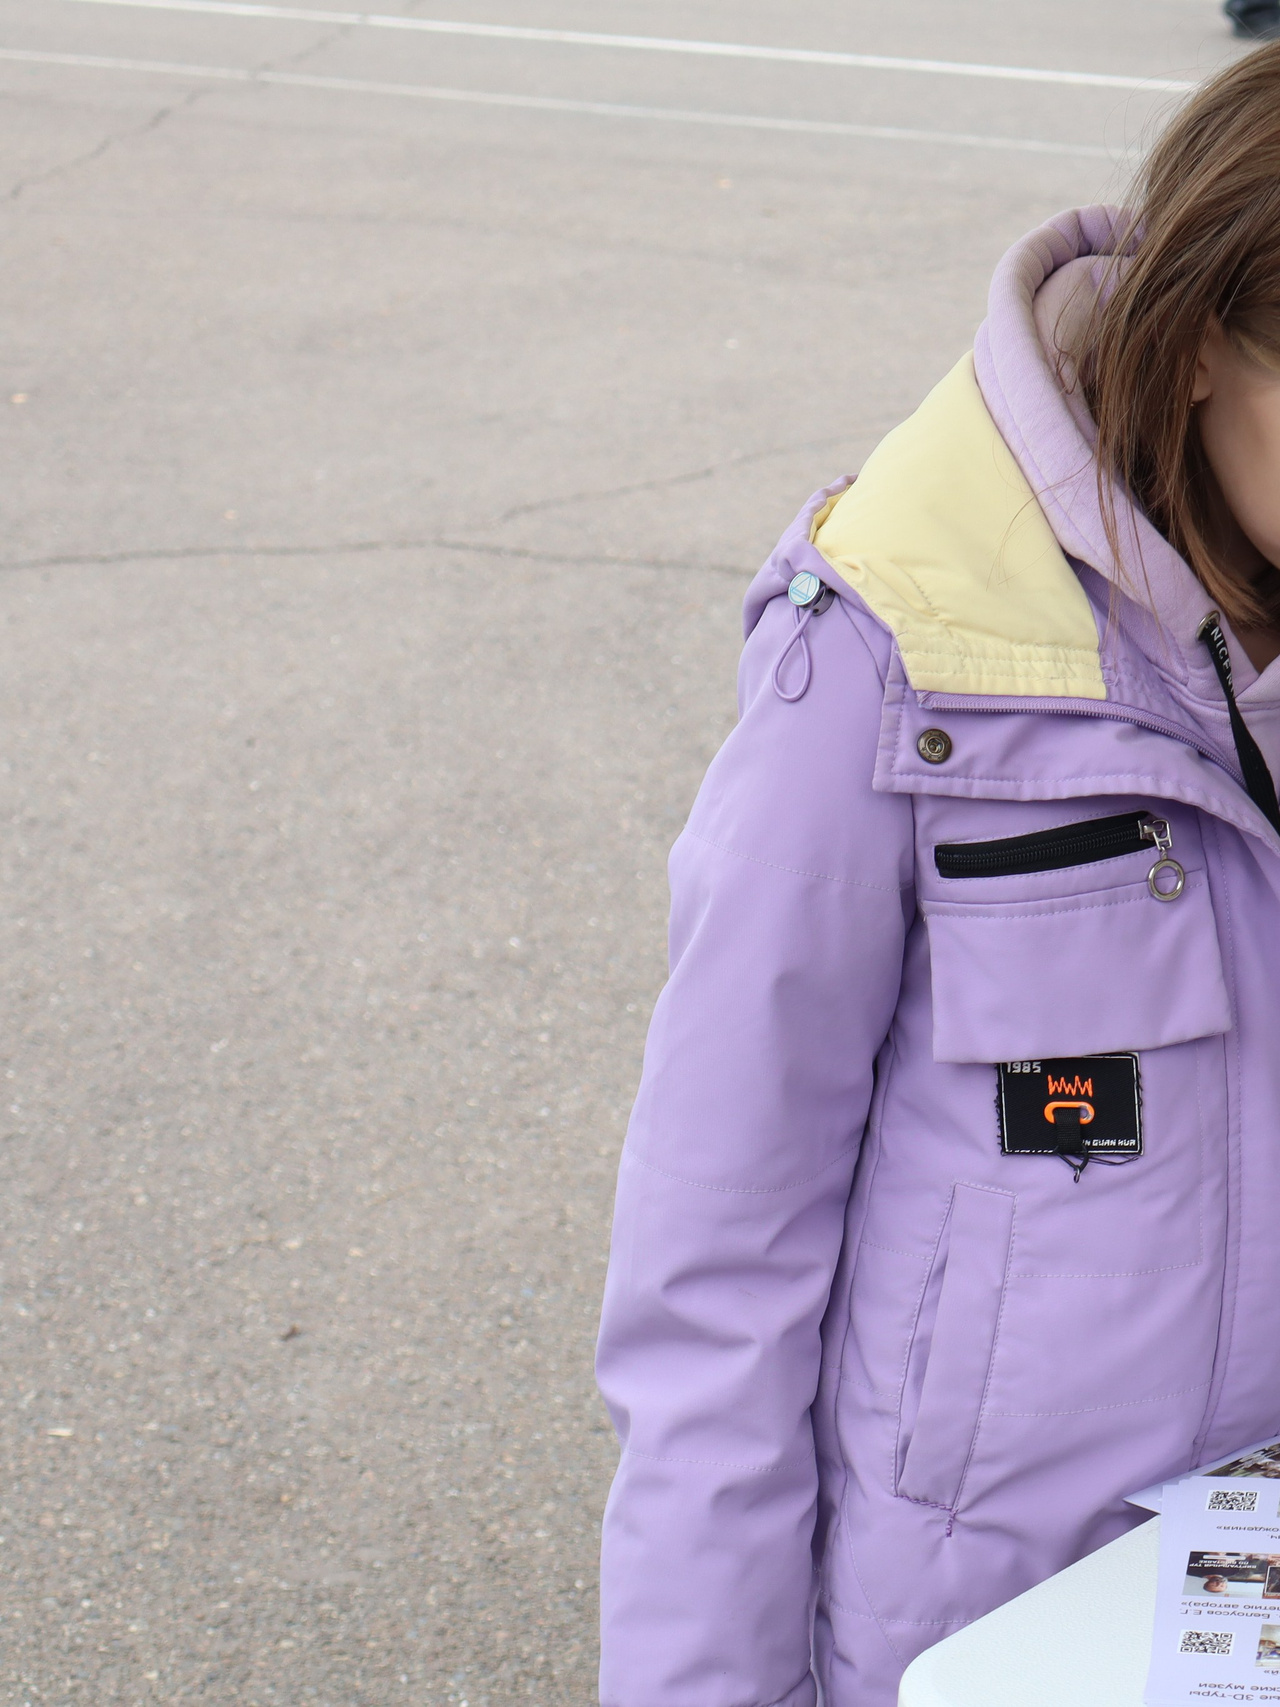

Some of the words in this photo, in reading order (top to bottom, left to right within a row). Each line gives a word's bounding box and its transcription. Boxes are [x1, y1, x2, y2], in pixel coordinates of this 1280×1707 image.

[1006, 1061, 1042, 1073] 1985
[1181, 1600, 1240, 1610] автора)»
[1206, 1610, 1272, 1619] Белоусов
[1198, 1682, 1246, 1692] музеи
[1188, 1690, 1255, 1700] 3D-туры
